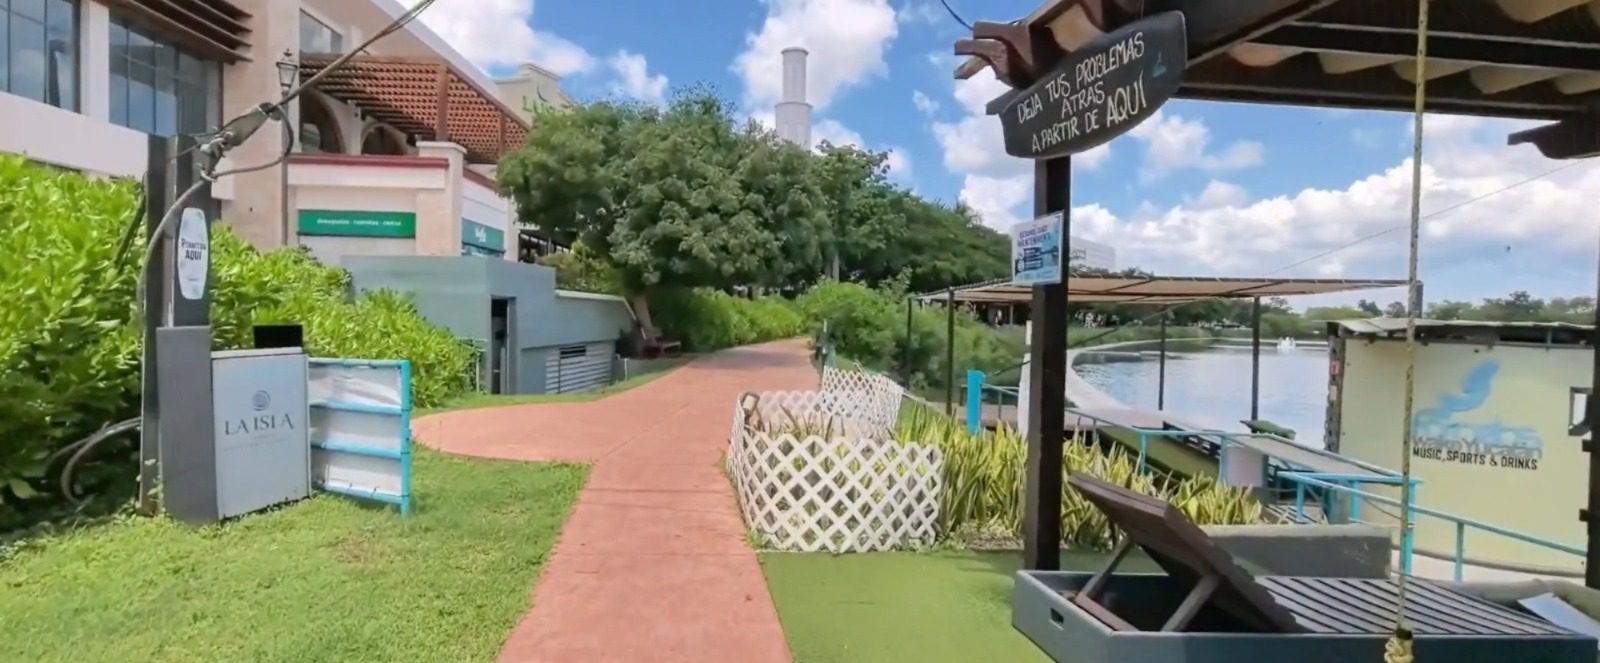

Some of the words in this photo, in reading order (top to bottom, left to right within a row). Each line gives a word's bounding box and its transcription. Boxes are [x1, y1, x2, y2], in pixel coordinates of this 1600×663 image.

[1017, 92, 1043, 124] DEJA
[1045, 73, 1071, 102] TUS
[1076, 32, 1145, 90] PROBLEMAS
[1061, 81, 1105, 119] ATRAS
[1085, 108, 1100, 133] DE
[225, 418, 249, 436] LA
[254, 413, 294, 431] ISLA
[1489, 455, 1498, 468] &
[1501, 456, 1538, 471] DRINKS
